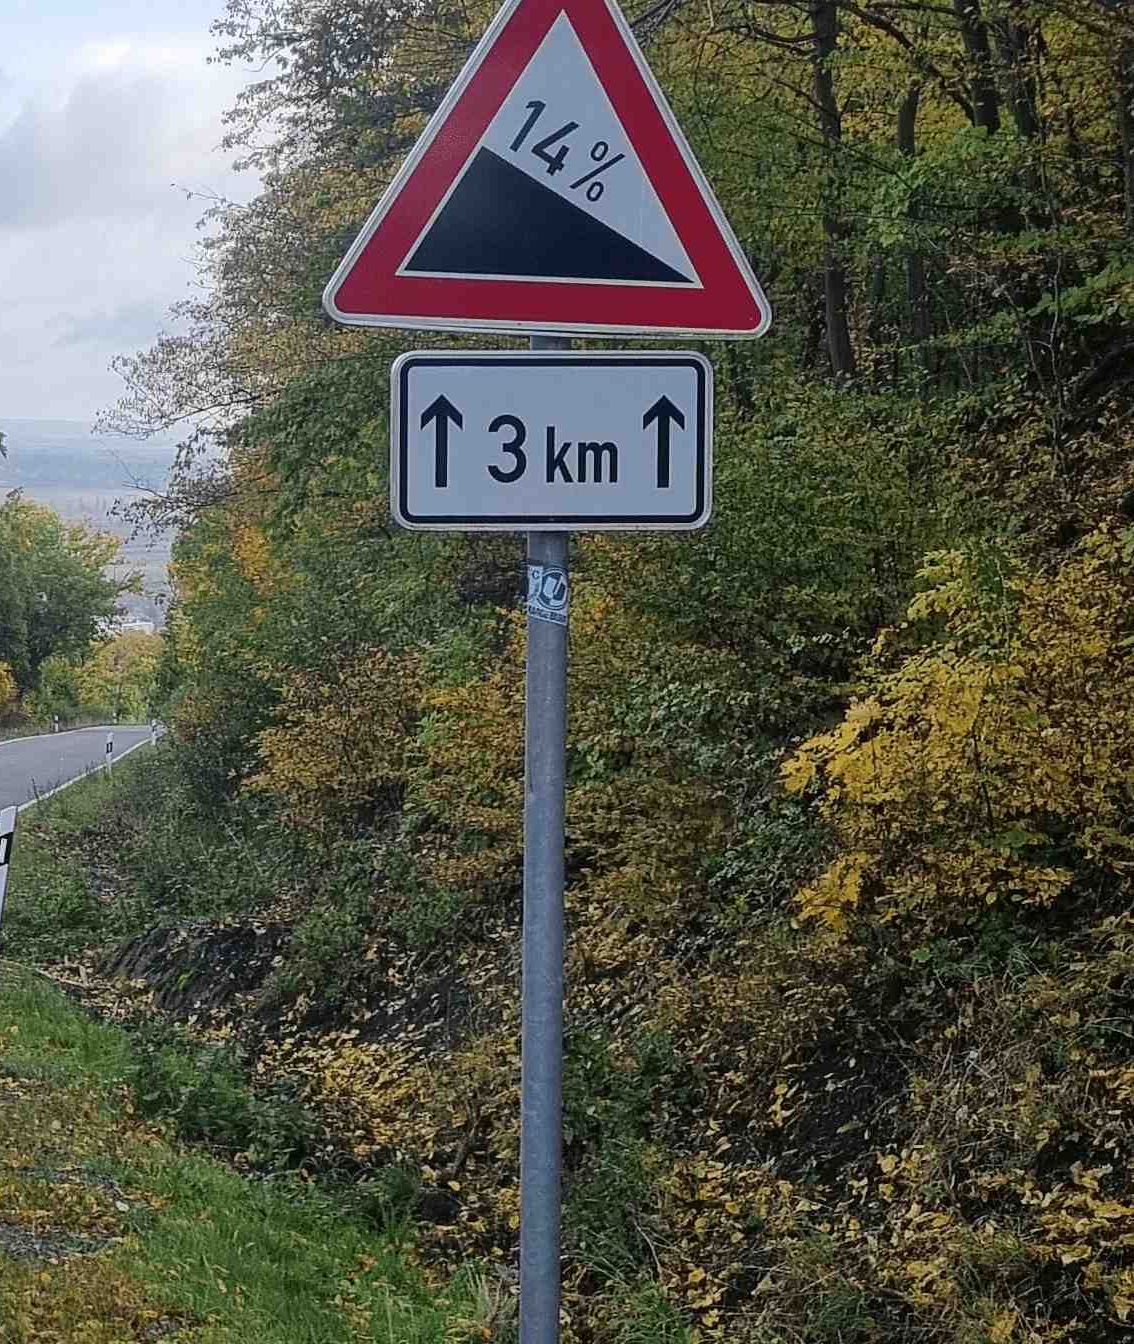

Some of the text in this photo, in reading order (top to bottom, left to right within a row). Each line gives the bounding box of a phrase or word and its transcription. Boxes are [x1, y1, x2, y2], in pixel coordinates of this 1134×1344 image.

[509, 100, 625, 202] 14%
[488, 414, 619, 484] 3 km
